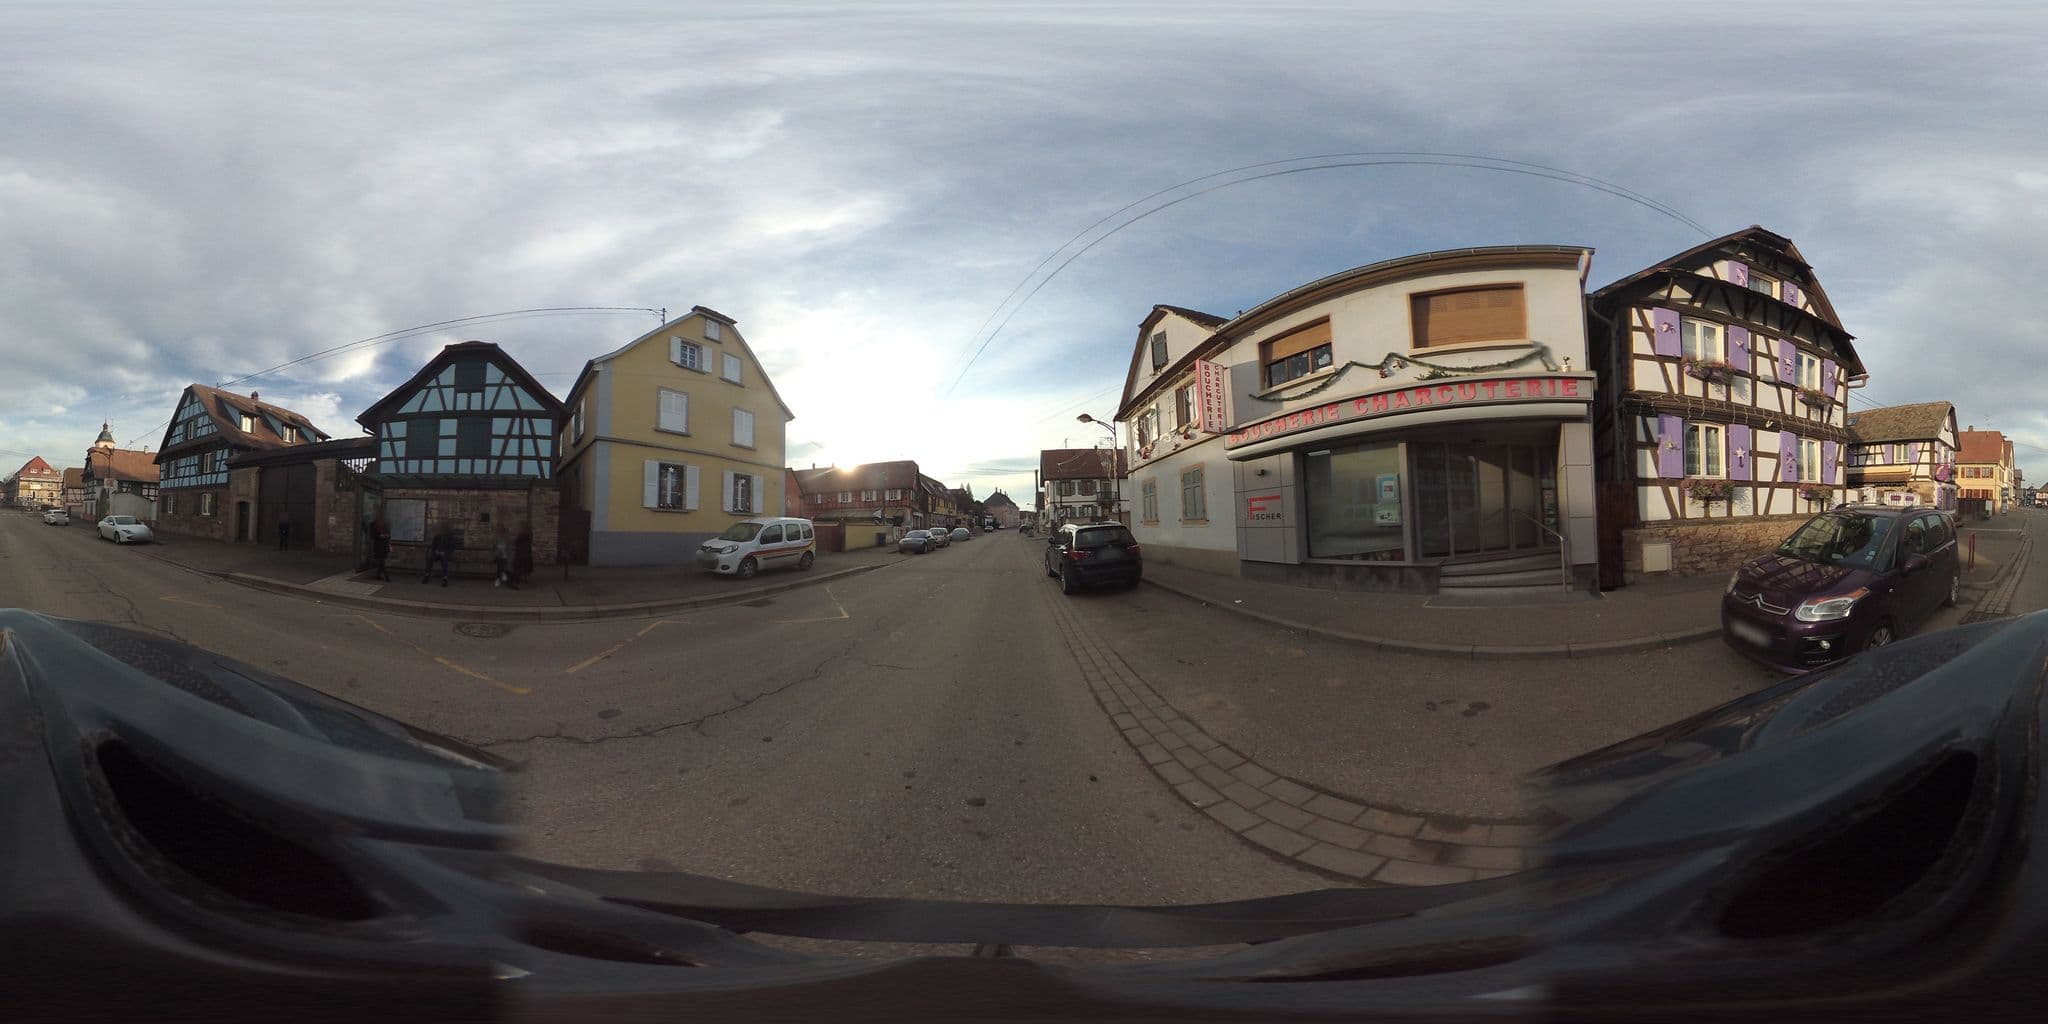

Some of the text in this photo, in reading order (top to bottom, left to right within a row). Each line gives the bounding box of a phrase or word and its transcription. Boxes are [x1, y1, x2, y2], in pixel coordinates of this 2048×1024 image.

[1204, 364, 1214, 429] BOUCHERIE
[1214, 365, 1223, 433] CHARCUTERIE
[1230, 378, 1578, 444] BOUCHERIE CHARCUTERIE
